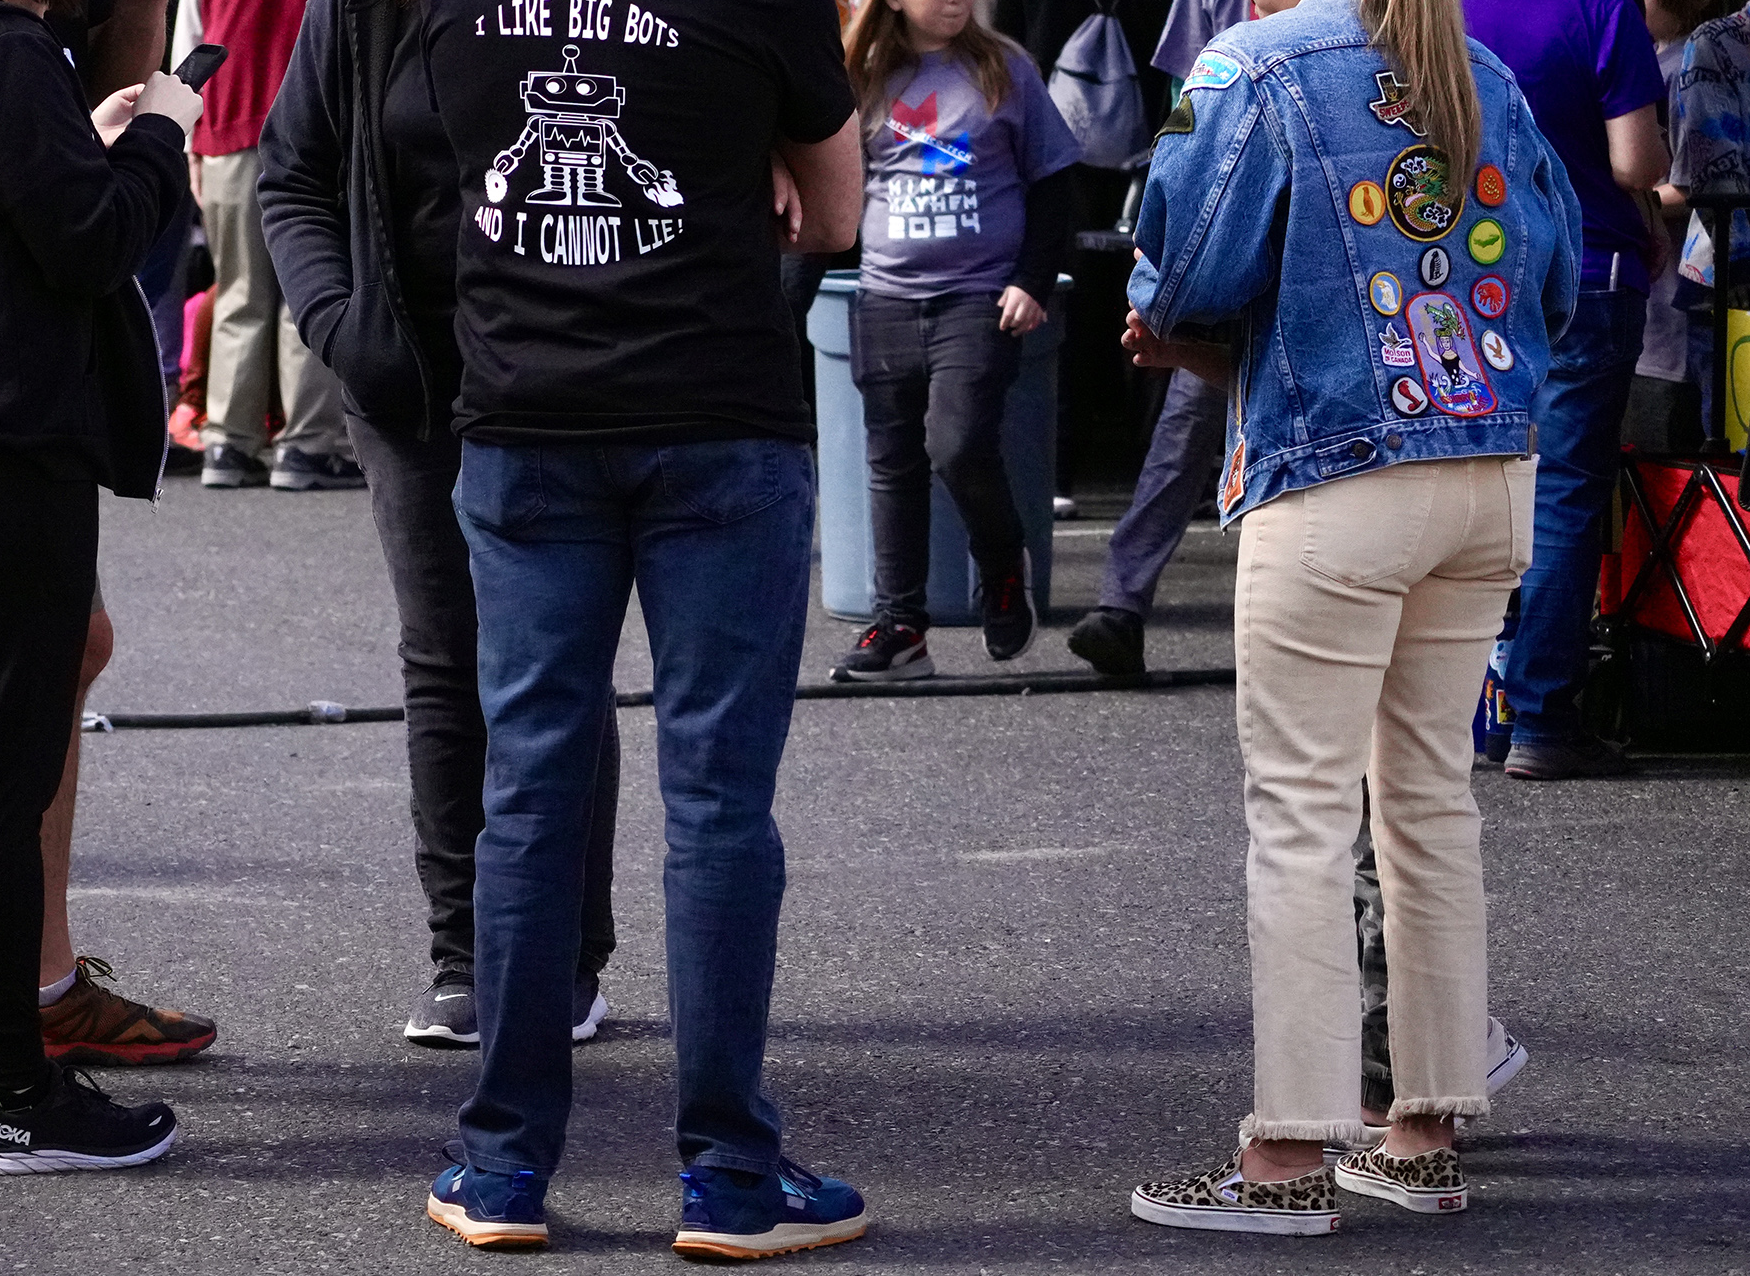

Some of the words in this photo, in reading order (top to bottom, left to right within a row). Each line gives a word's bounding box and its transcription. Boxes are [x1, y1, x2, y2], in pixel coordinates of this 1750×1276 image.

[475, 14, 485, 36] I
[622, 3, 679, 48] BOTS
[887, 178, 977, 196] MINER
[887, 194, 978, 214] MAYHEM
[474, 205, 503, 243] AND
[513, 211, 528, 256] I
[539, 213, 622, 266] CANNOT
[634, 218, 683, 256] LIE!
[887, 212, 981, 240] 2024
